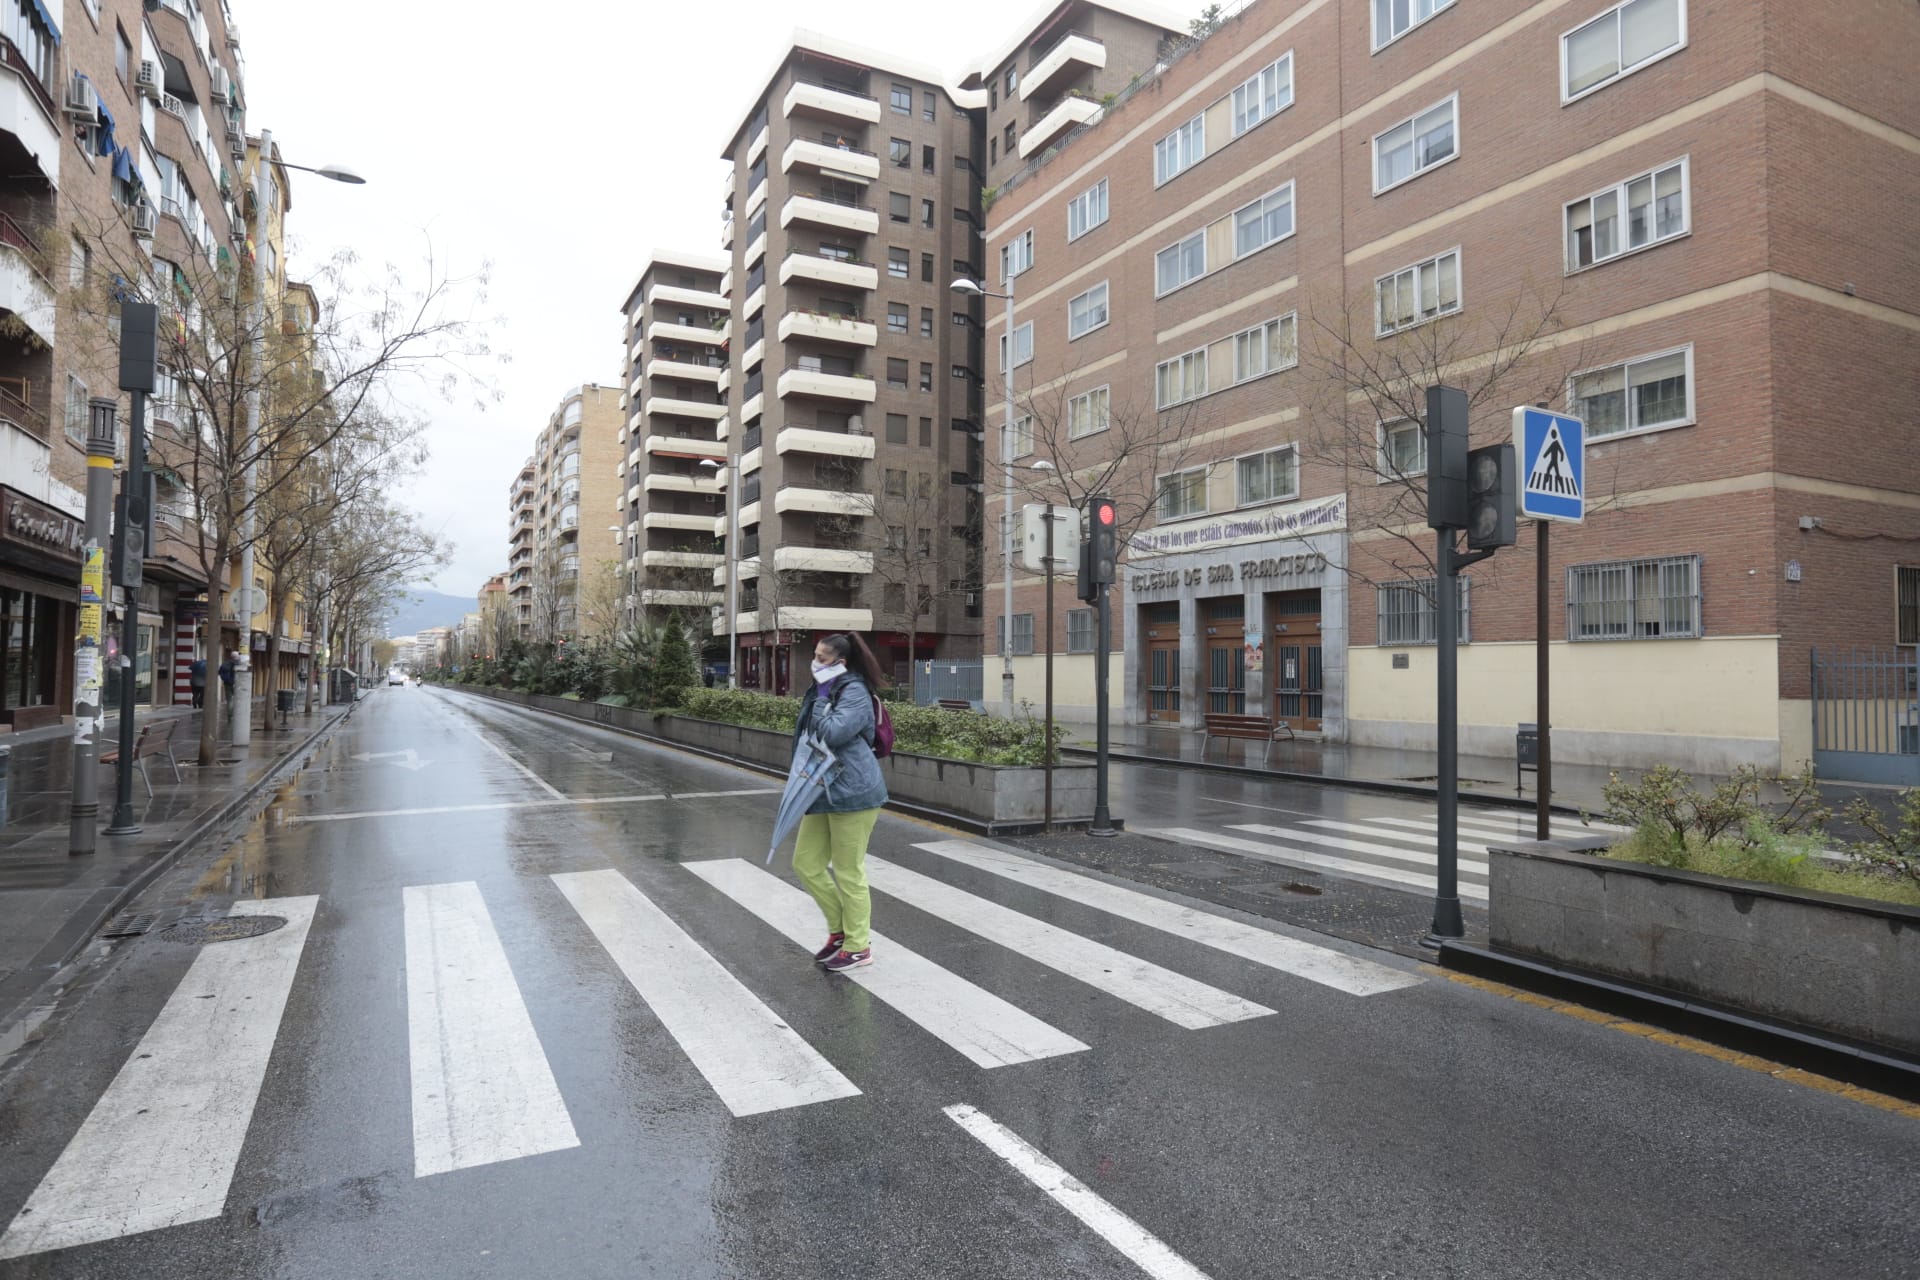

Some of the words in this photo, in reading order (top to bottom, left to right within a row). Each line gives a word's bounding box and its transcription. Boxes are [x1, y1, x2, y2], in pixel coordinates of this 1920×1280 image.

[1153, 535, 1159, 549] a
[1171, 530, 1182, 547] los
[1184, 529, 1198, 547] que
[1200, 523, 1222, 542] estáis
[1224, 519, 1264, 538] cansados
[1265, 518, 1270, 534] y
[1273, 518, 1285, 533] yo
[1286, 513, 1298, 529] os
[1132, 570, 1179, 592] IGLESIA
[1184, 567, 1202, 586] DE
[1207, 563, 1234, 584] SAN
[1239, 551, 1327, 580] FRANCISCO
